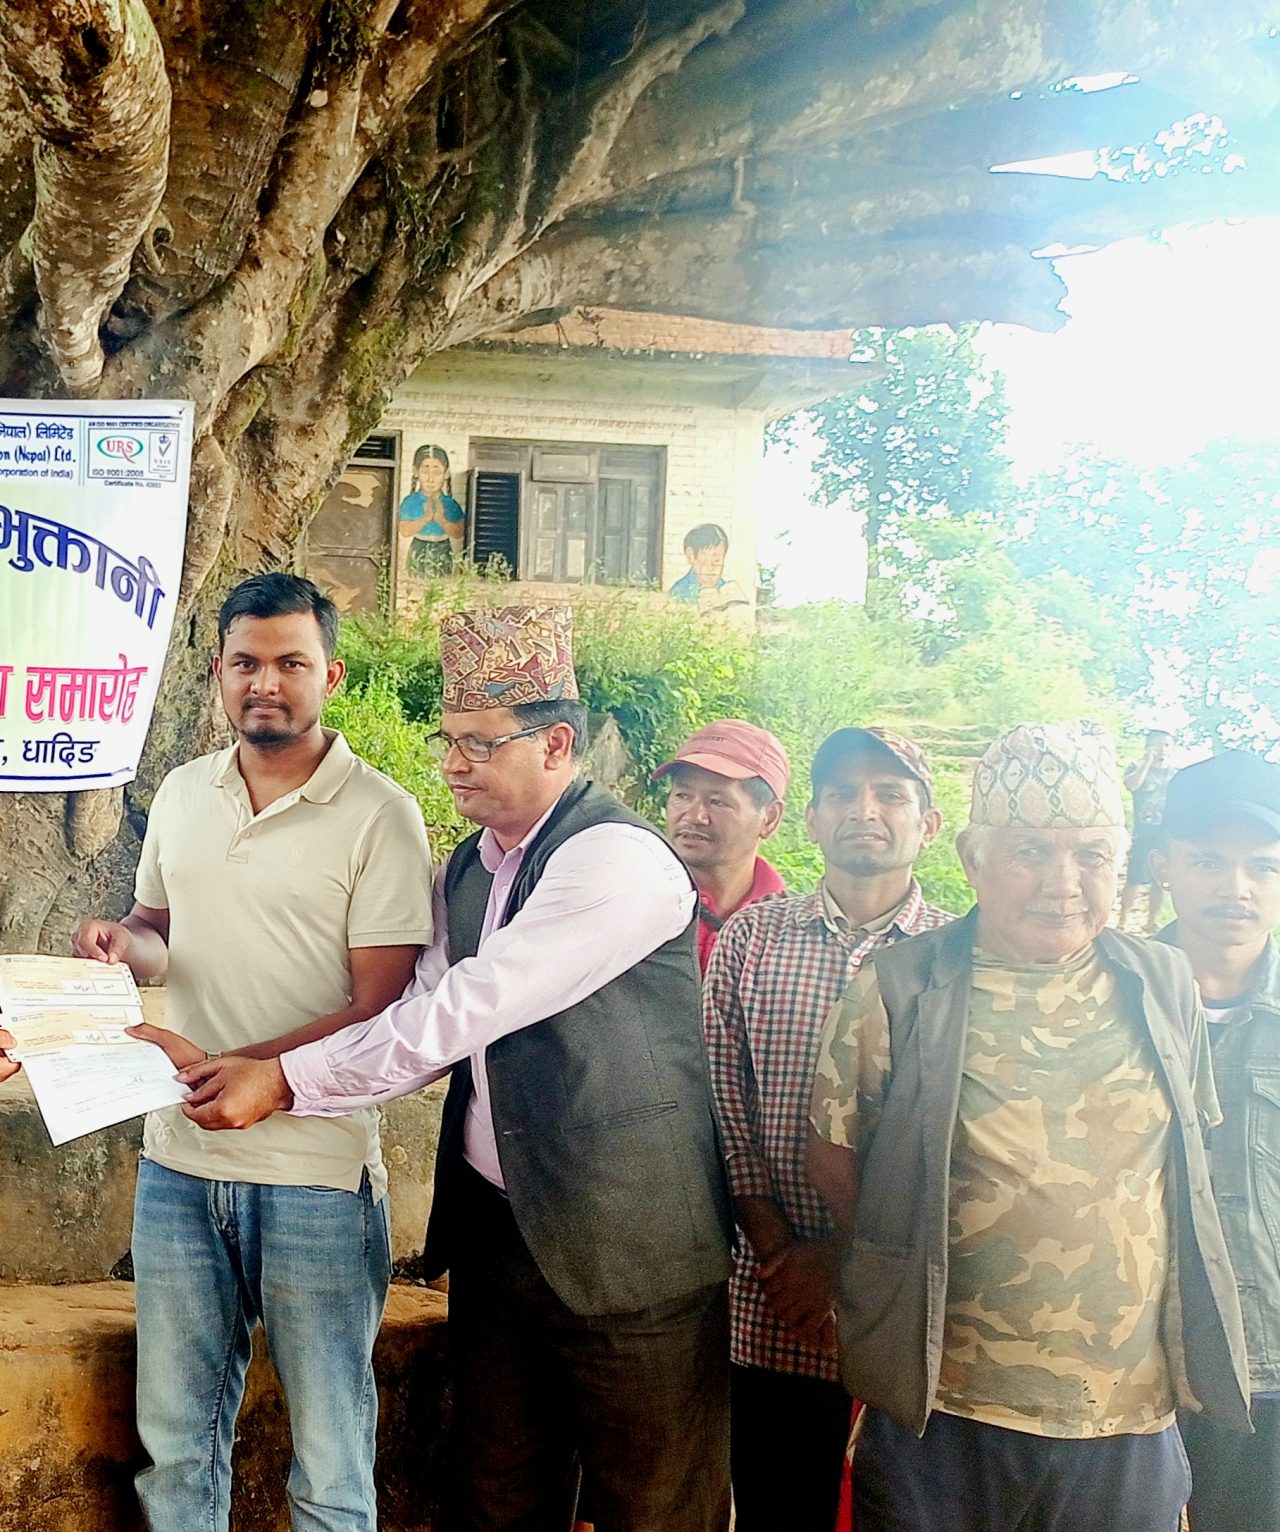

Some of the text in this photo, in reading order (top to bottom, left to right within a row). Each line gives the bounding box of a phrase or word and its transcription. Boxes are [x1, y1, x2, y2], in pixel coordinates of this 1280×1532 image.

[36, 422, 73, 440] लिमिटेड
[14, 445, 50, 464] (Nepal)
[55, 446, 76, 462] Ltd.
[106, 440, 136, 464] URS
[40, 469, 49, 477] of
[51, 469, 73, 480] India)
[25, 653, 148, 724] समारोह
